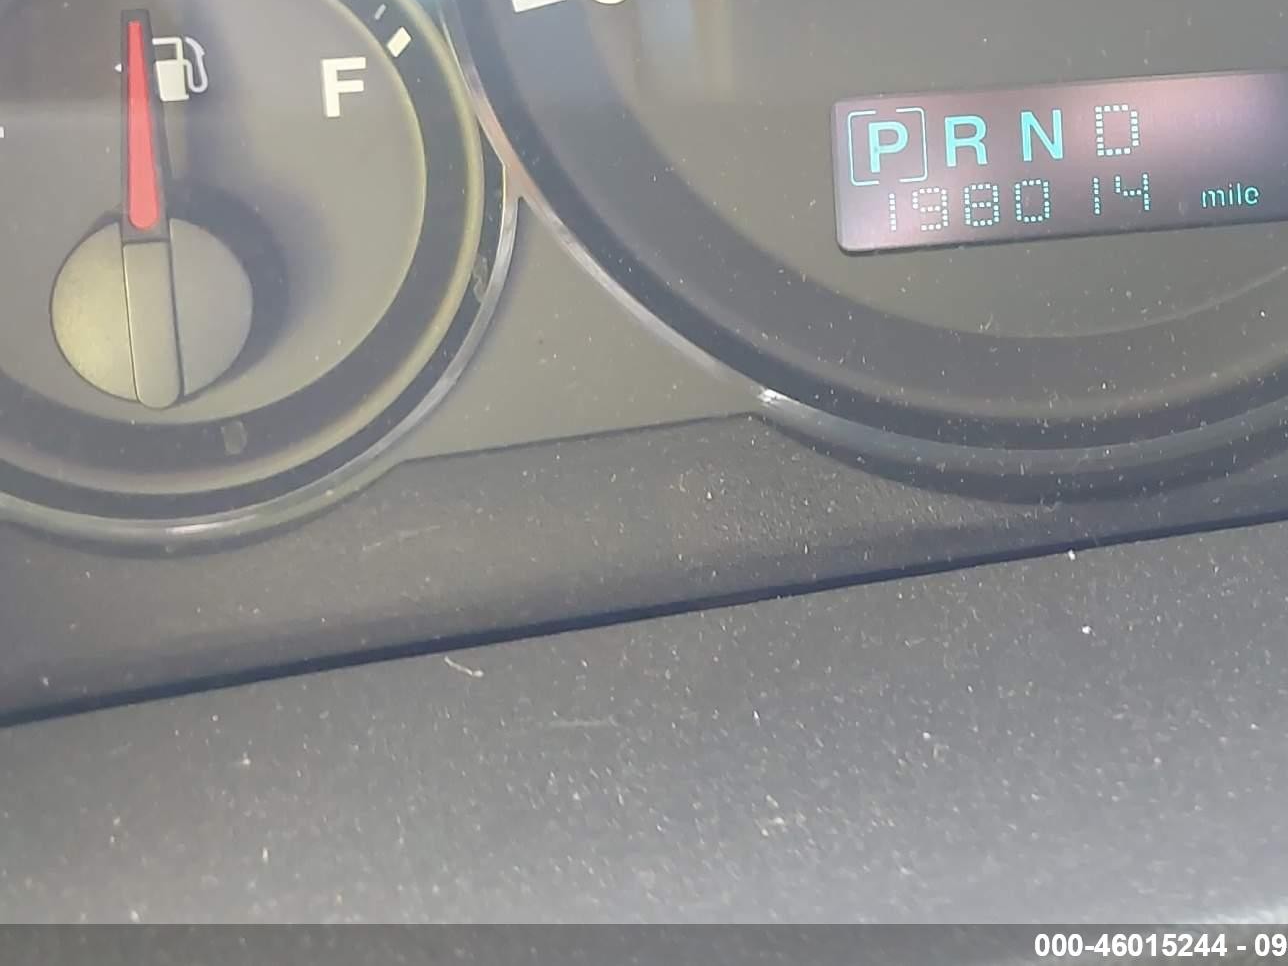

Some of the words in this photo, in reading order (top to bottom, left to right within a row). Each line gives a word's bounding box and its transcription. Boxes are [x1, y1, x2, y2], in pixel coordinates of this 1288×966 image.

[321, 56, 366, 117] F
[868, 121, 909, 173] P
[944, 115, 988, 168] R
[1020, 109, 1063, 162] N
[1095, 103, 1140, 156] D
[887, 173, 1151, 232] 198014
[1201, 183, 1260, 210] mile
